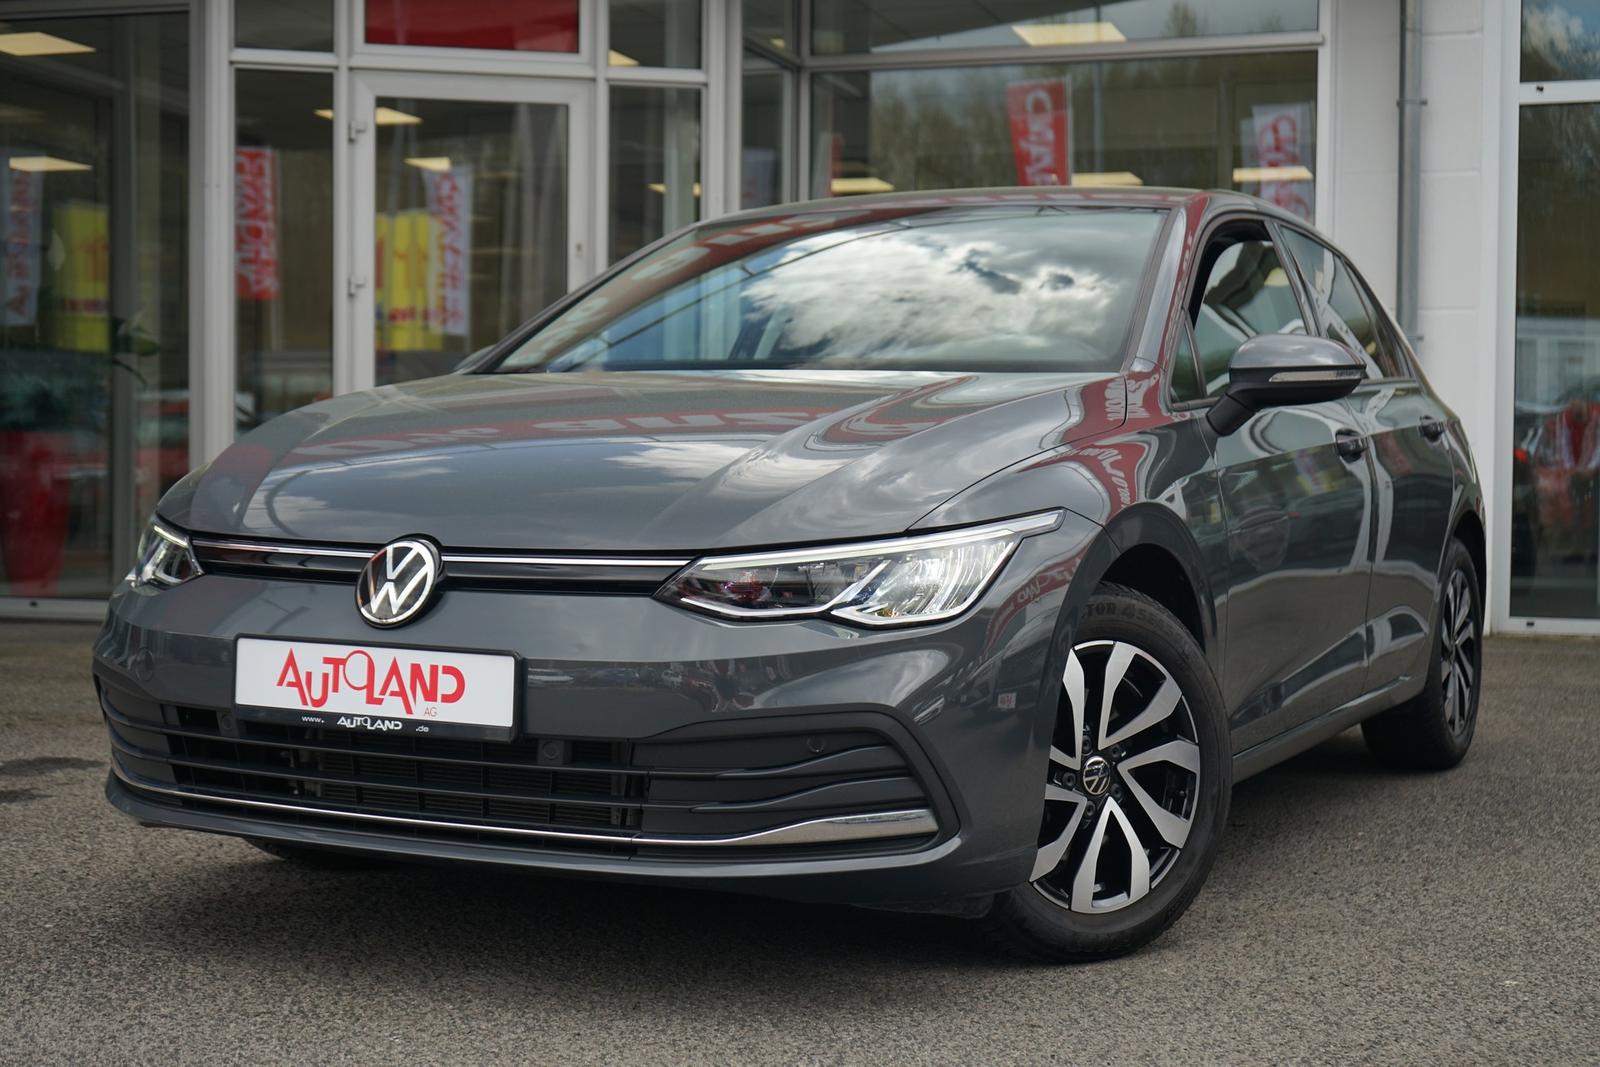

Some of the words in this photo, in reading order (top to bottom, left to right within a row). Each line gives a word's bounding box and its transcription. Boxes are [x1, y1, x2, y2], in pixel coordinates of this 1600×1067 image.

[424, 706, 437, 718] AG
[302, 715, 324, 724] www.
[337, 717, 403, 732] AUTOLAND
[415, 725, 429, 733] .de
